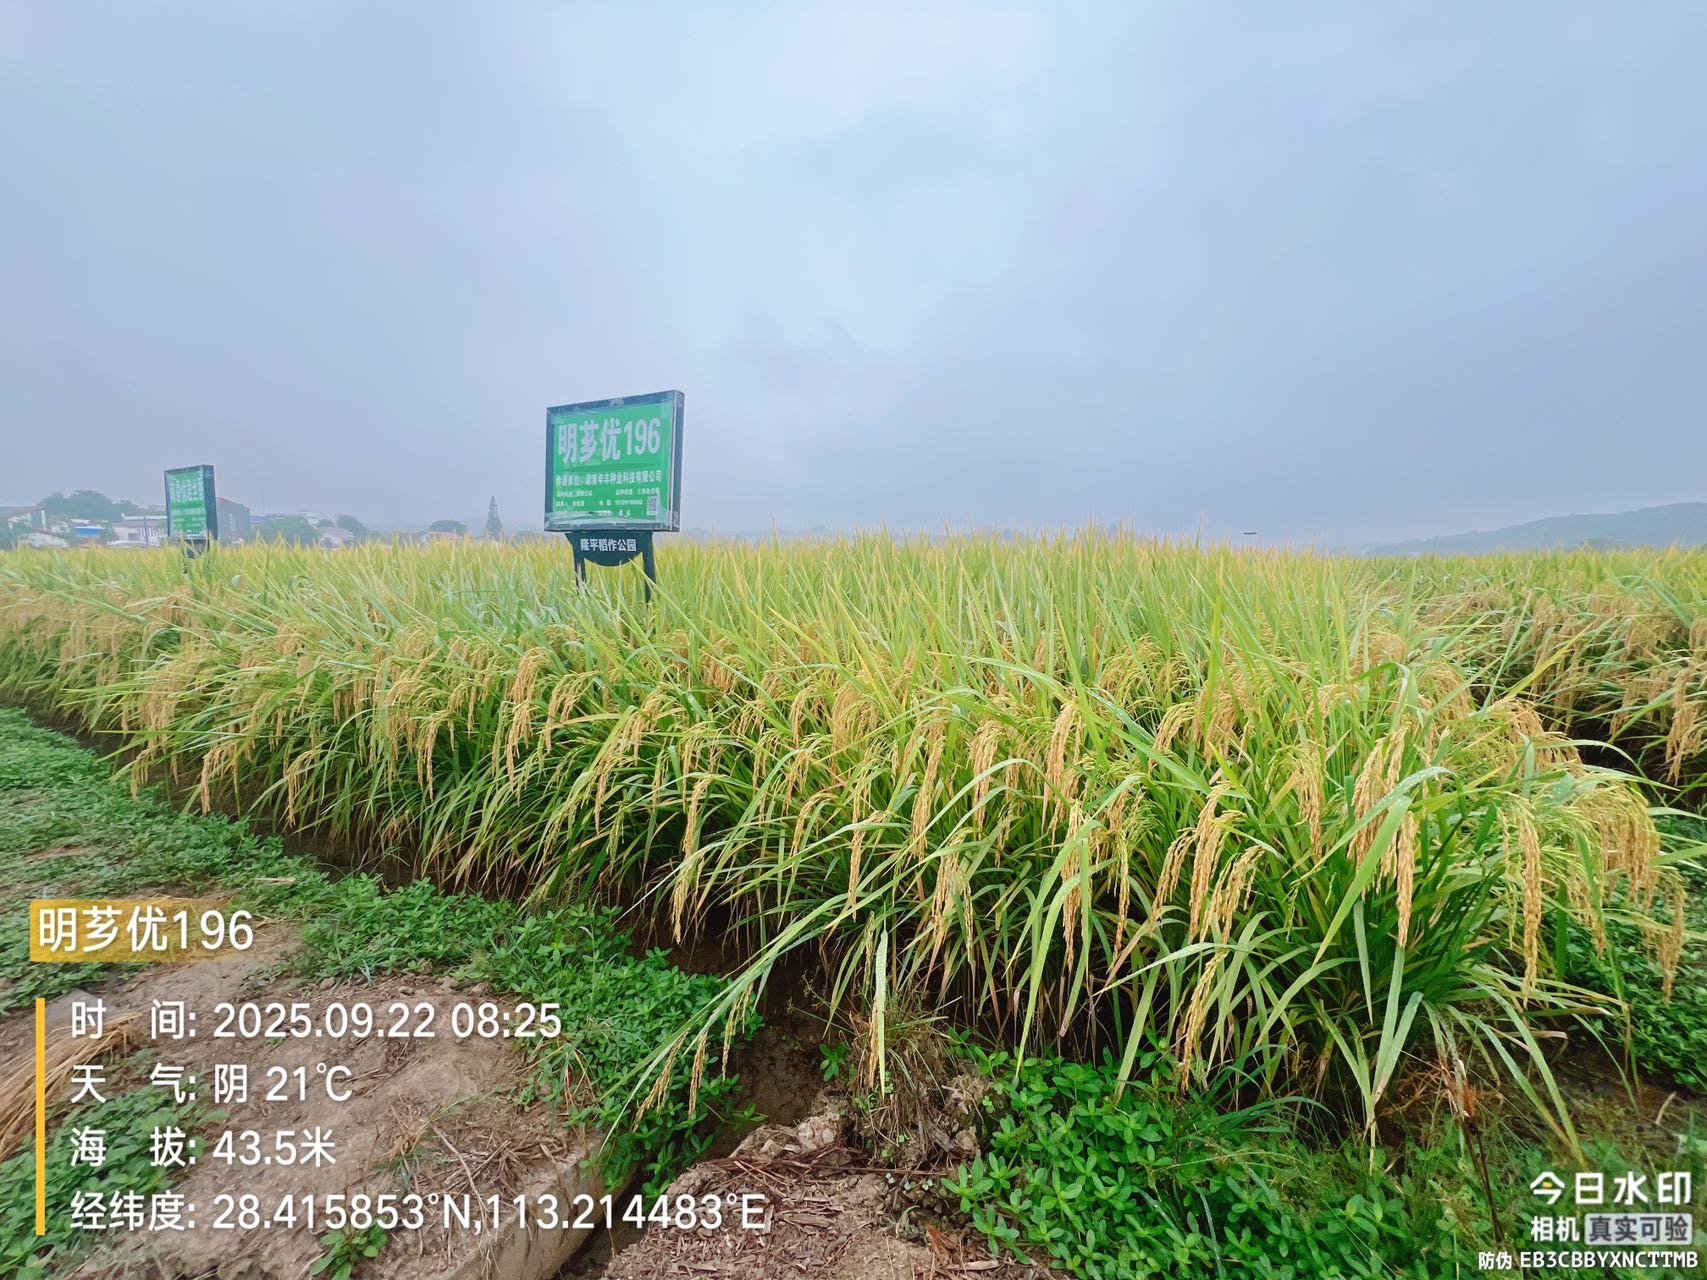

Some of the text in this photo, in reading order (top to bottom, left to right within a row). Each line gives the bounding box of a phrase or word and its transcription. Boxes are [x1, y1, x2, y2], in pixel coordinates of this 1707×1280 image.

[558, 416, 661, 465] 明芗优196
[580, 538, 637, 552] 隆平稻作公园
